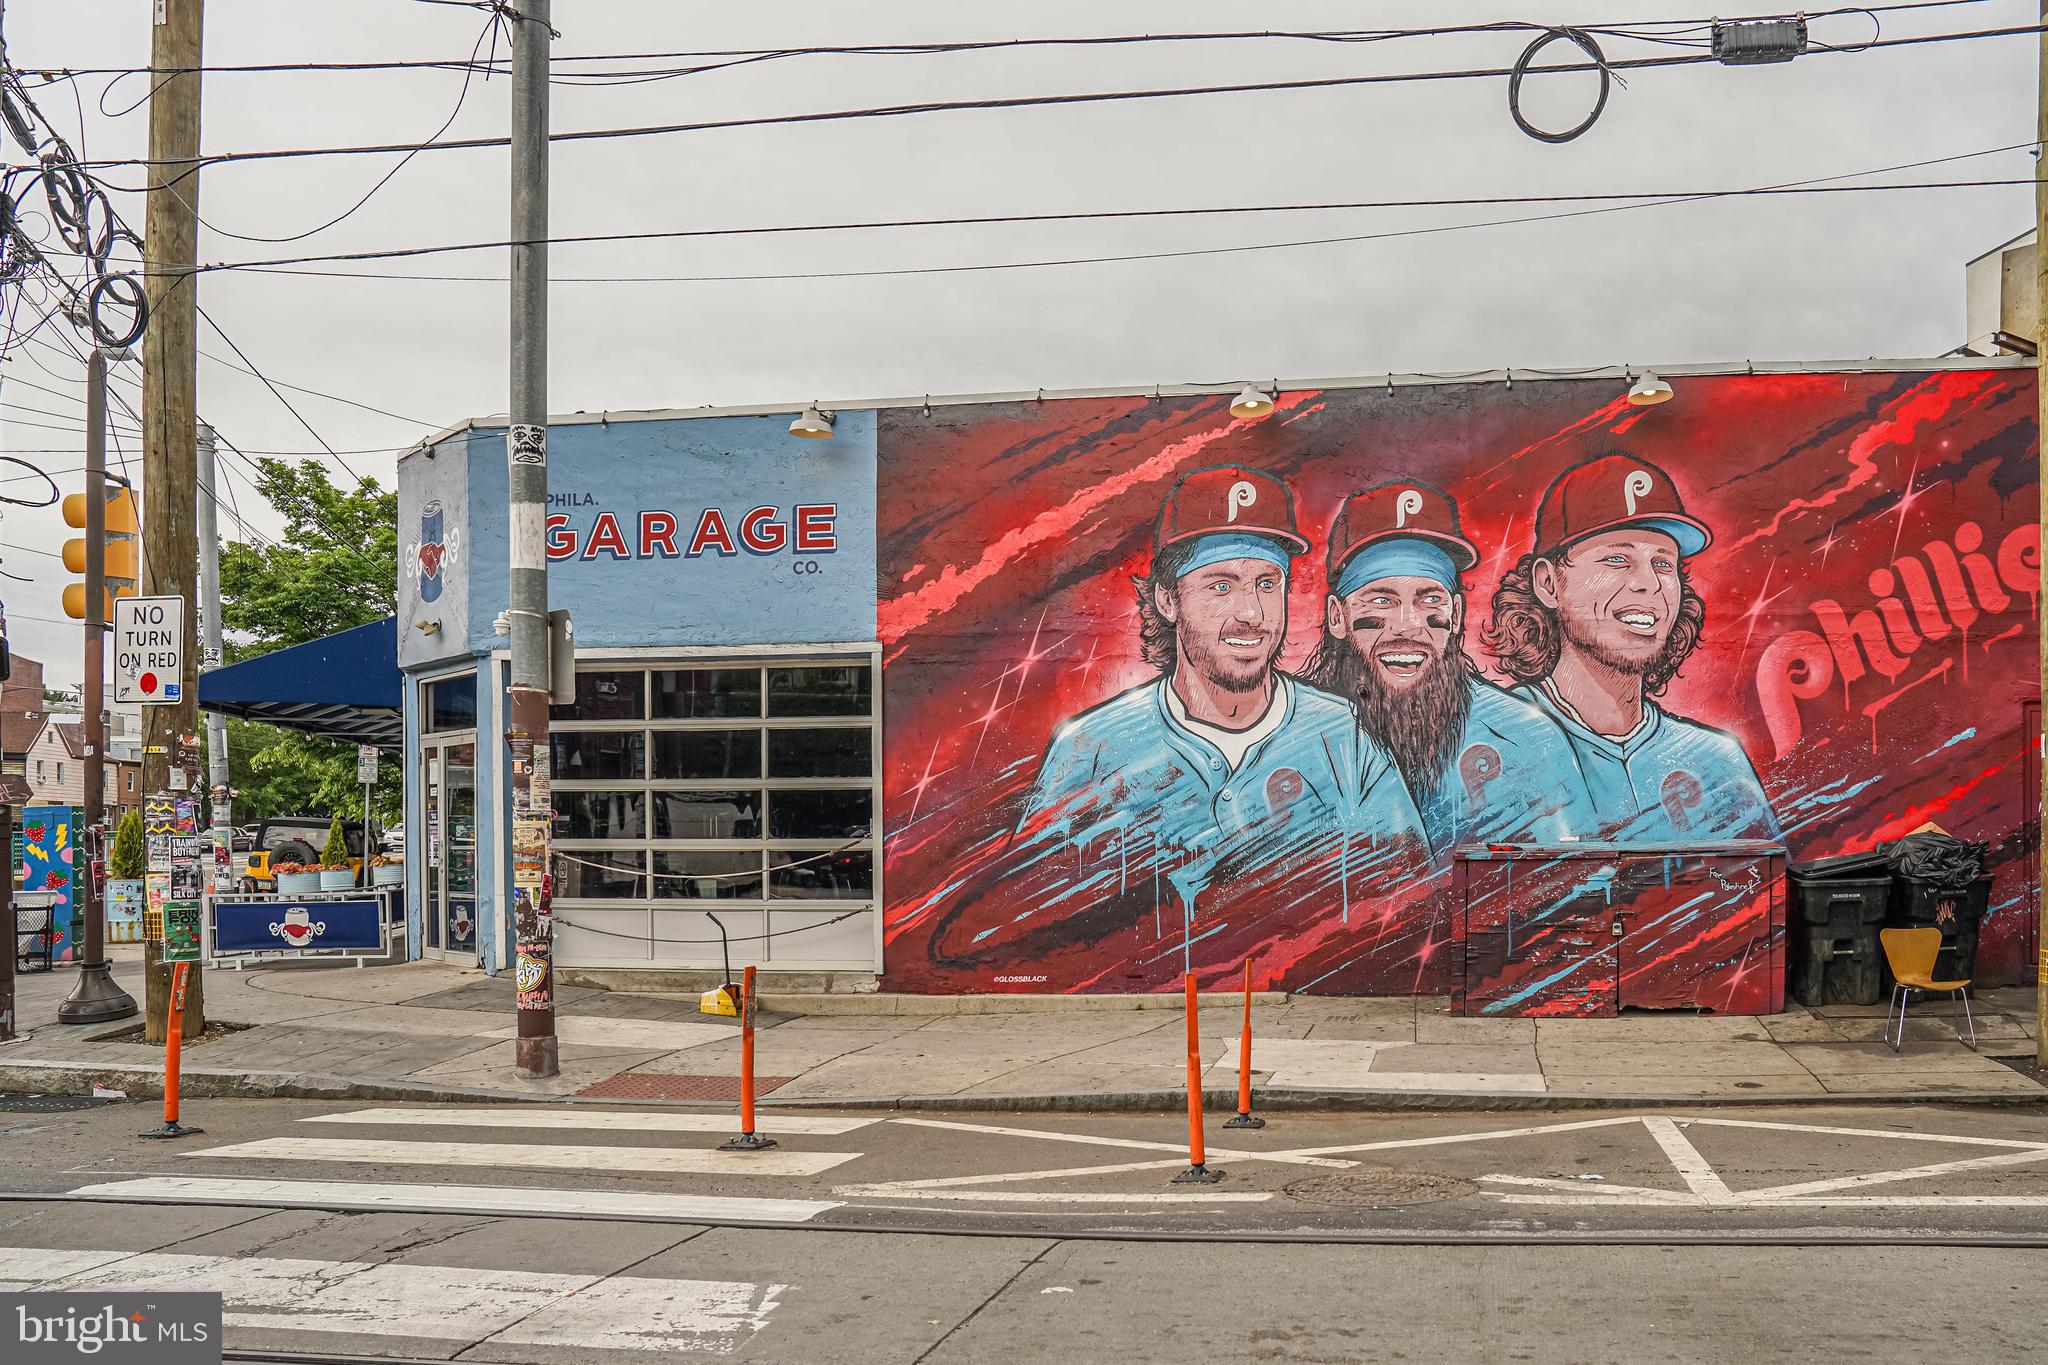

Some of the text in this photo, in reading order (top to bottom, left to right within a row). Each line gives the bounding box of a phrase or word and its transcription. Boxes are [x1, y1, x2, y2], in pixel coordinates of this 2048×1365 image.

[547, 503, 838, 563] GARAGE
[792, 560, 823, 575] CO.
[133, 606, 164, 625] NO
[125, 631, 172, 647] TURN
[119, 652, 177, 669] ON RED
[1709, 867, 1723, 880] Free
[173, 890, 186, 899] SILK
[169, 915, 200, 925] FOX
